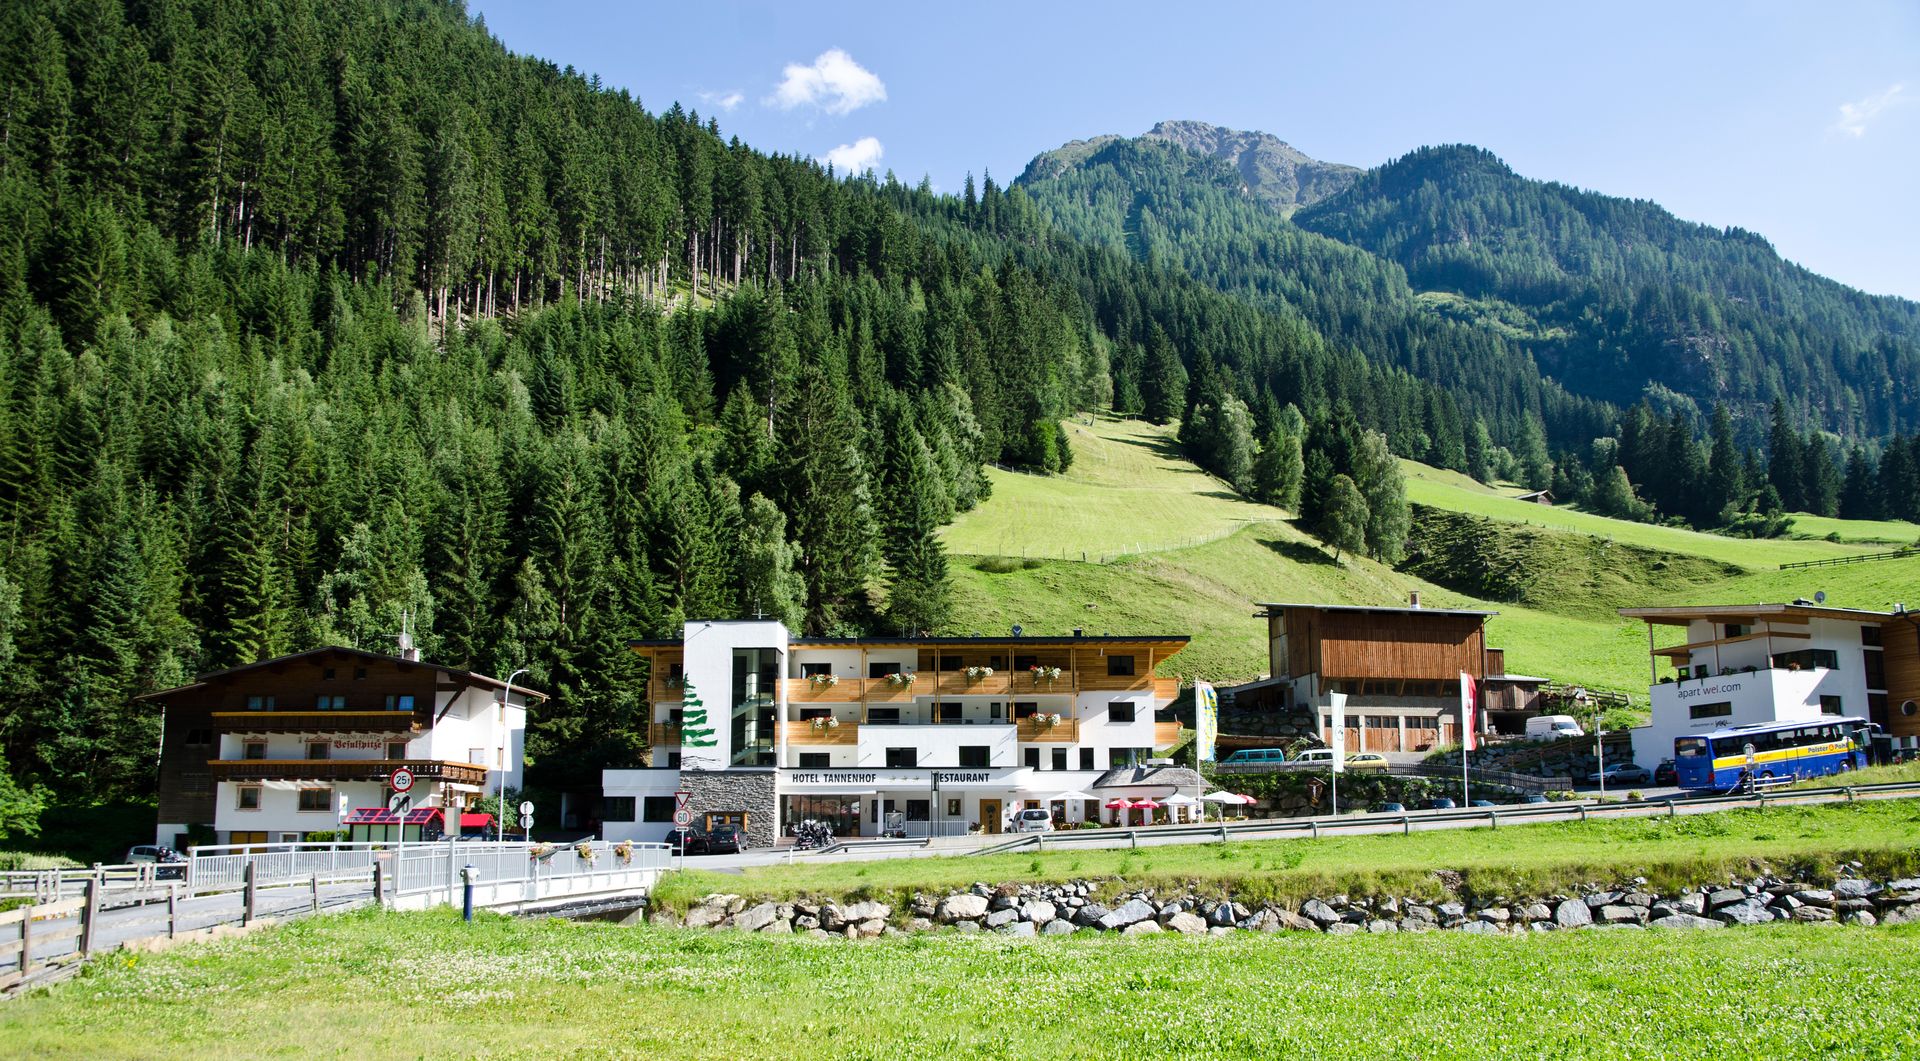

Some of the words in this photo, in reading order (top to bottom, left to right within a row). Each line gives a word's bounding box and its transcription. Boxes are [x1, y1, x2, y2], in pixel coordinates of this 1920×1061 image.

[1678, 689, 1701, 699] apart
[1702, 683, 1741, 695] wel.com
[792, 773, 820, 783] HOTEL
[823, 773, 876, 783] TANNENHOF
[677, 812, 688, 822] 60
